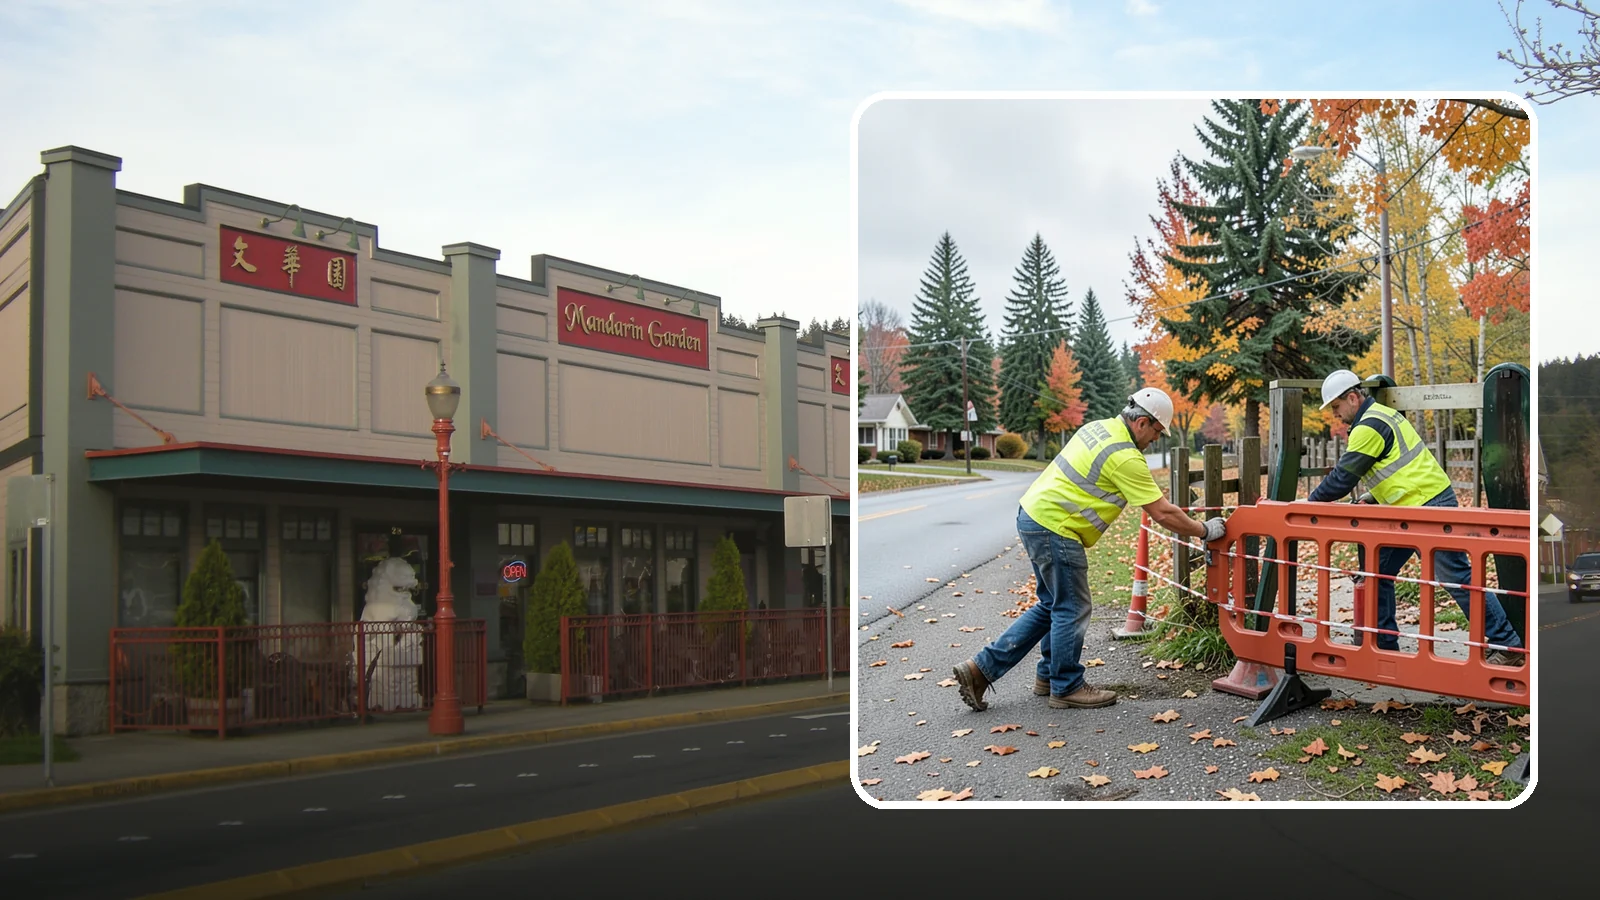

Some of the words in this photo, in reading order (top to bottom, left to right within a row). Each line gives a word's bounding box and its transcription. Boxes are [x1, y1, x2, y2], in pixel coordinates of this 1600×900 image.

[231, 235, 346, 291] 文華園
[564, 302, 644, 341] Mandarin
[647, 320, 702, 352] Garden
[503, 565, 527, 578] OPEN
